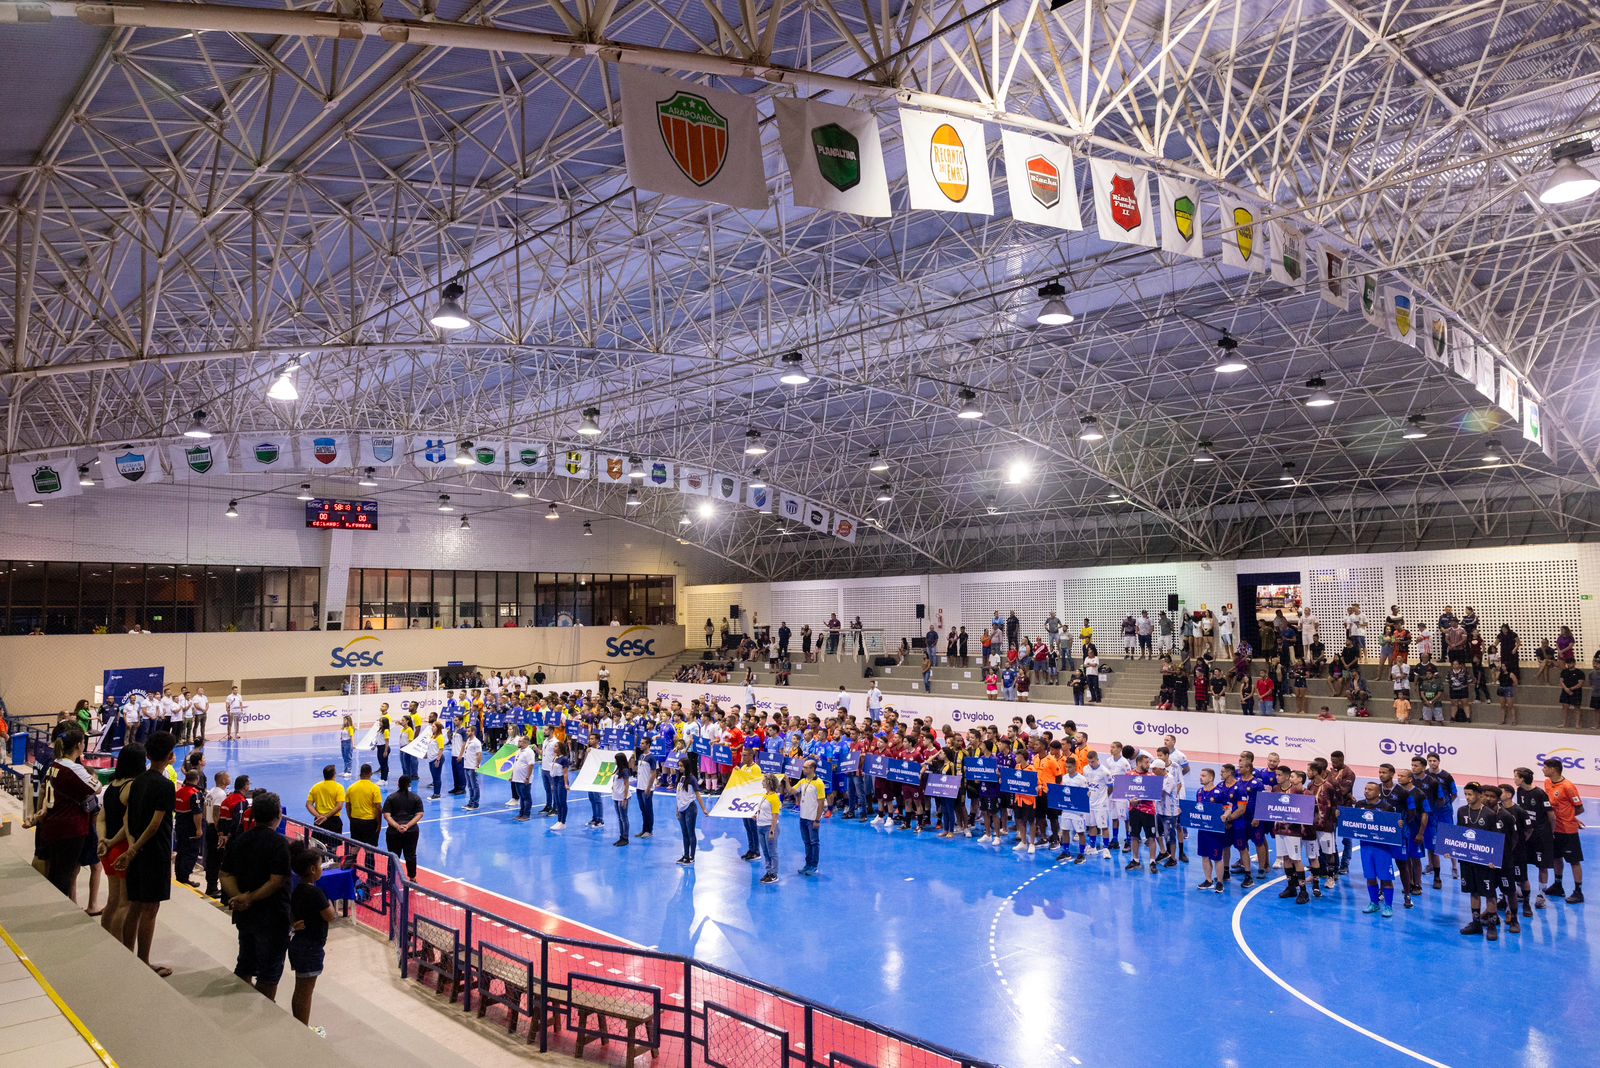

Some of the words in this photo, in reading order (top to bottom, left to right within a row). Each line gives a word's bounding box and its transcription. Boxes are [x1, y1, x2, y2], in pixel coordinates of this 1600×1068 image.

[668, 106, 718, 125] ARAPOANGA
[816, 144, 858, 162] PLANALTINA
[933, 145, 963, 166] RECANTO
[947, 164, 965, 181] EMAS
[1030, 174, 1058, 186] Riacho
[1112, 193, 1137, 205] Riacho
[1114, 201, 1136, 211] Fundo
[606, 637, 656, 658] Sesc
[330, 647, 384, 669] Sesc
[756, 700, 772, 709] Sesc
[312, 708, 338, 719] Sesc
[962, 711, 995, 723] tvglobo
[1036, 719, 1062, 731] Sesc
[1146, 722, 1190, 736] tvglobo
[1244, 732, 1279, 746] Sesc
[1398, 741, 1457, 756] tvglobo
[1007, 778, 1031, 788] SOBRADINHO
[1189, 812, 1201, 820] PARK
[1267, 804, 1301, 814] PLANALTINA
[1342, 820, 1367, 830] RECANTO
[1367, 823, 1379, 832] DAS
[1379, 825, 1397, 834] EMAS
[1444, 838, 1468, 849] RIACHO
[1468, 842, 1490, 854] FUNDO
